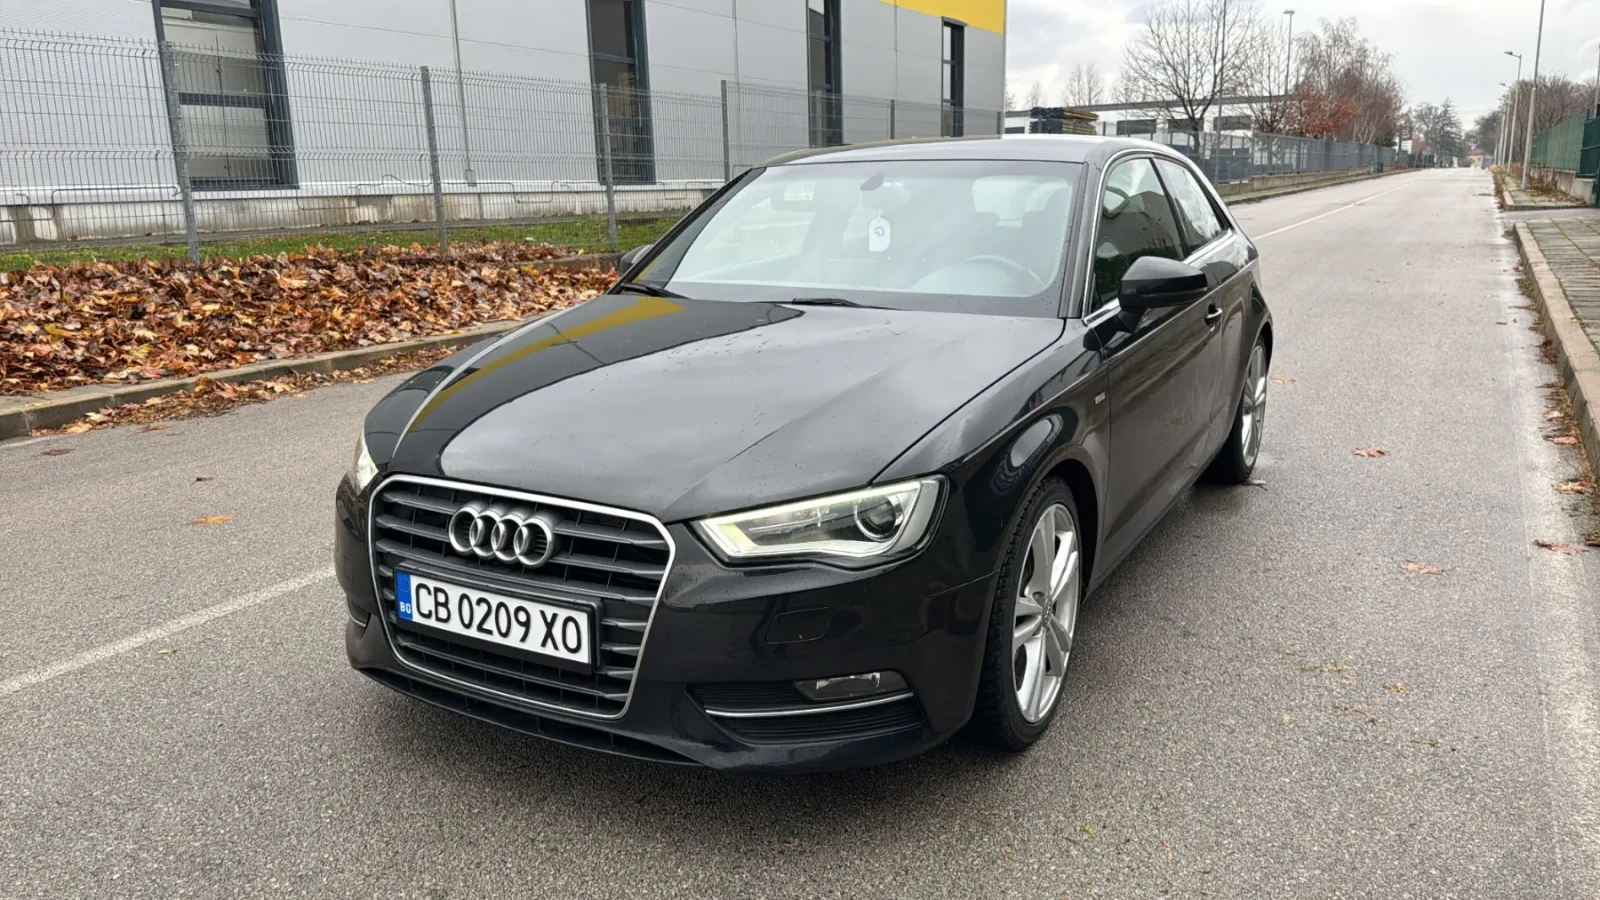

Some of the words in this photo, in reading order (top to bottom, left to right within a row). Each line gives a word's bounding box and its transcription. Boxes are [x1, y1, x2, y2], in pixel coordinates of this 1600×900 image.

[400, 601, 412, 614] BG
[415, 583, 451, 623] CB
[458, 593, 531, 643] 0209
[539, 609, 582, 654] XO
